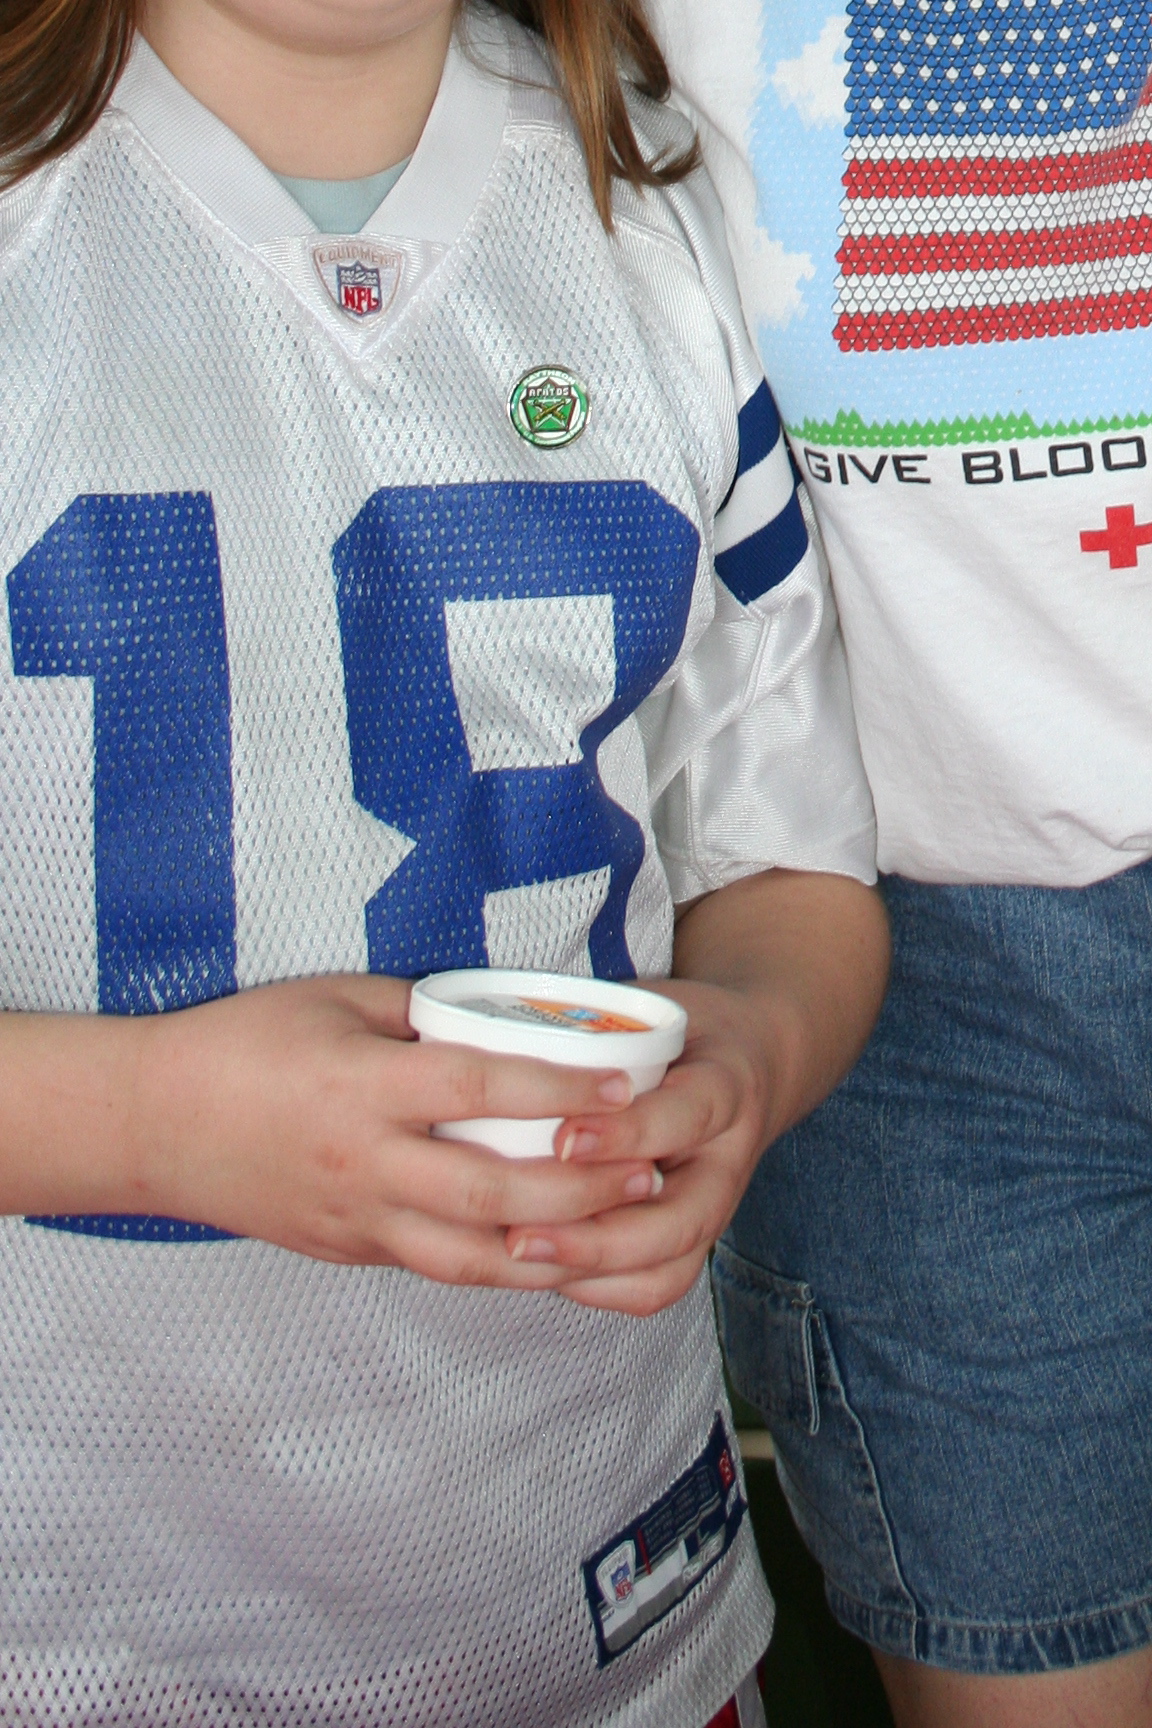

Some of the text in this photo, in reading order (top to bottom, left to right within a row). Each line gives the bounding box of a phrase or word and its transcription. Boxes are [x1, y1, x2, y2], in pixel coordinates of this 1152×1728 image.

[340, 284, 378, 314] NFL
[802, 447, 932, 486] GIVE
[4, 480, 701, 1242] 18
